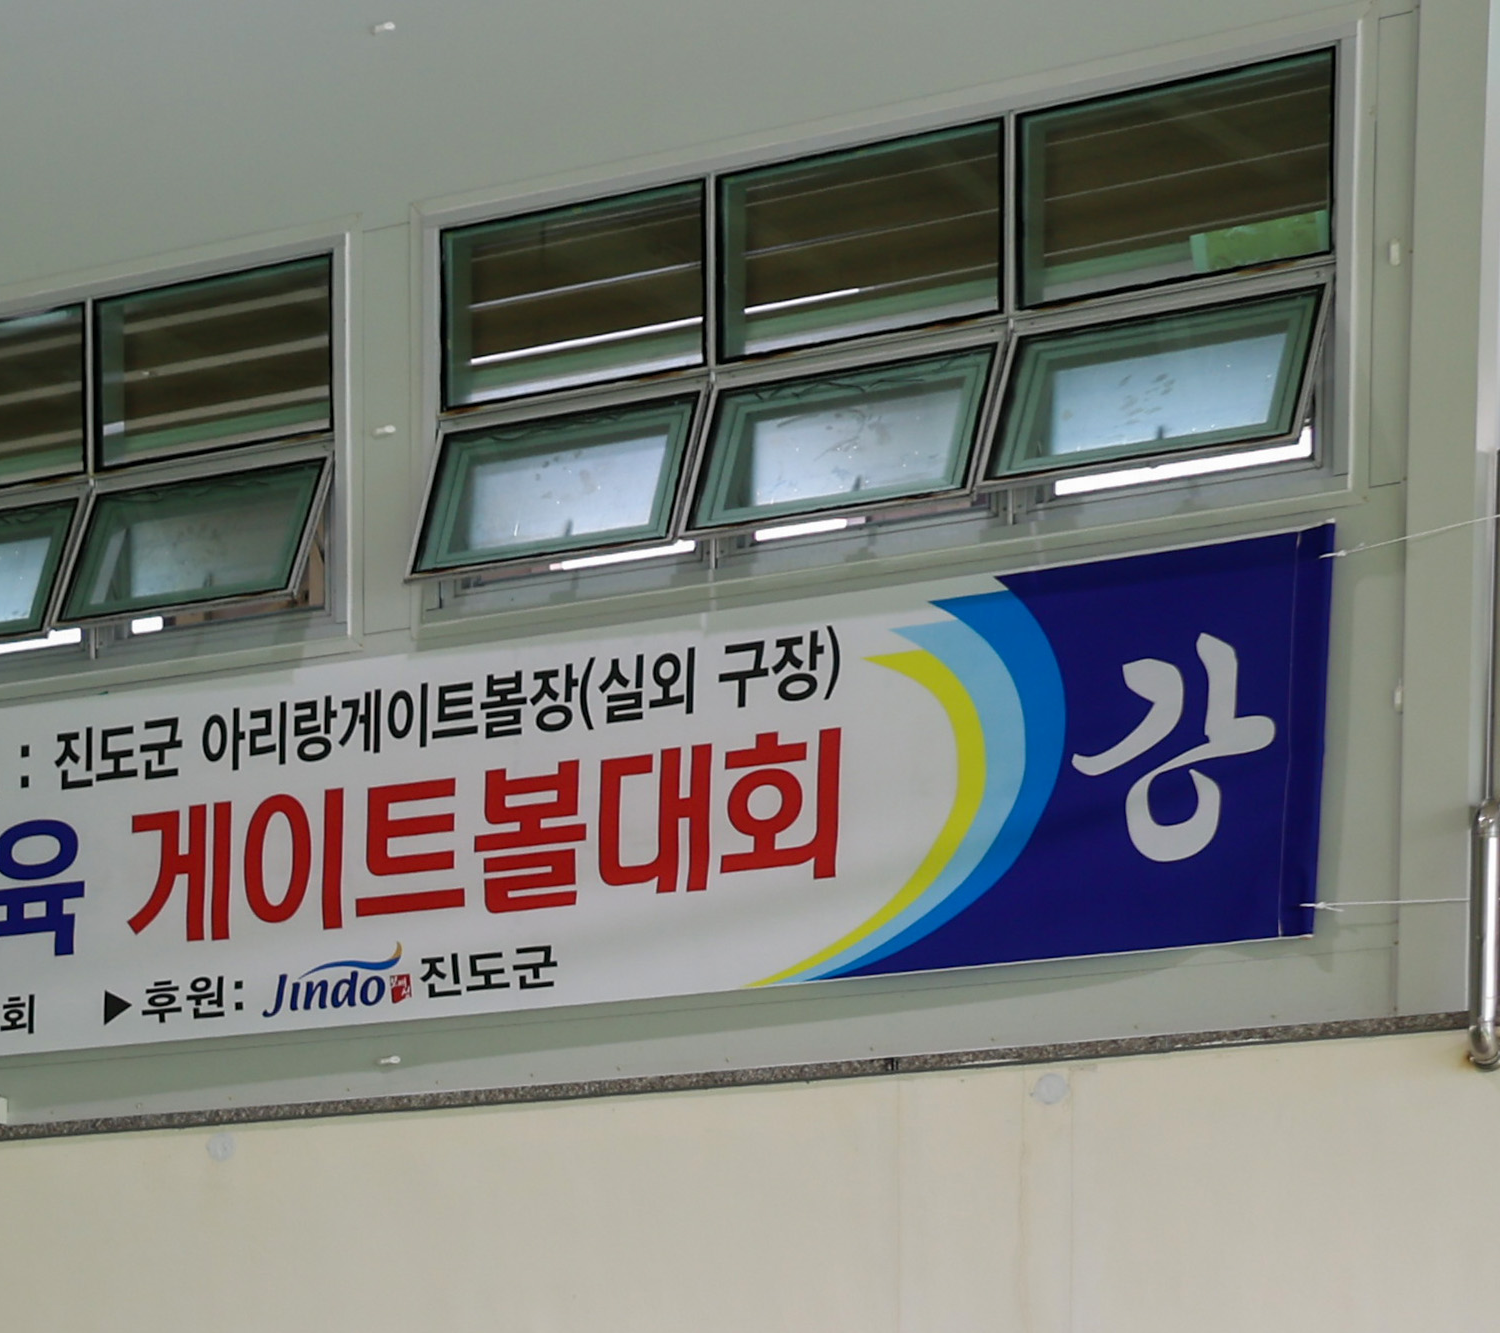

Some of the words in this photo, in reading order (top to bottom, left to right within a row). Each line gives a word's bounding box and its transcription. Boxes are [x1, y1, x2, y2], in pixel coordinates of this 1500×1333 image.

[53, 715, 184, 791] 진도군
[201, 646, 697, 771] 아리랑게이트볼장(실외
[718, 624, 842, 707] 구장)
[1072, 633, 1276, 863] 강
[126, 727, 842, 943] 게이트볼대회
[140, 974, 245, 1024] 후원:
[262, 970, 386, 1018] Jindo
[420, 944, 558, 999] 진도군
